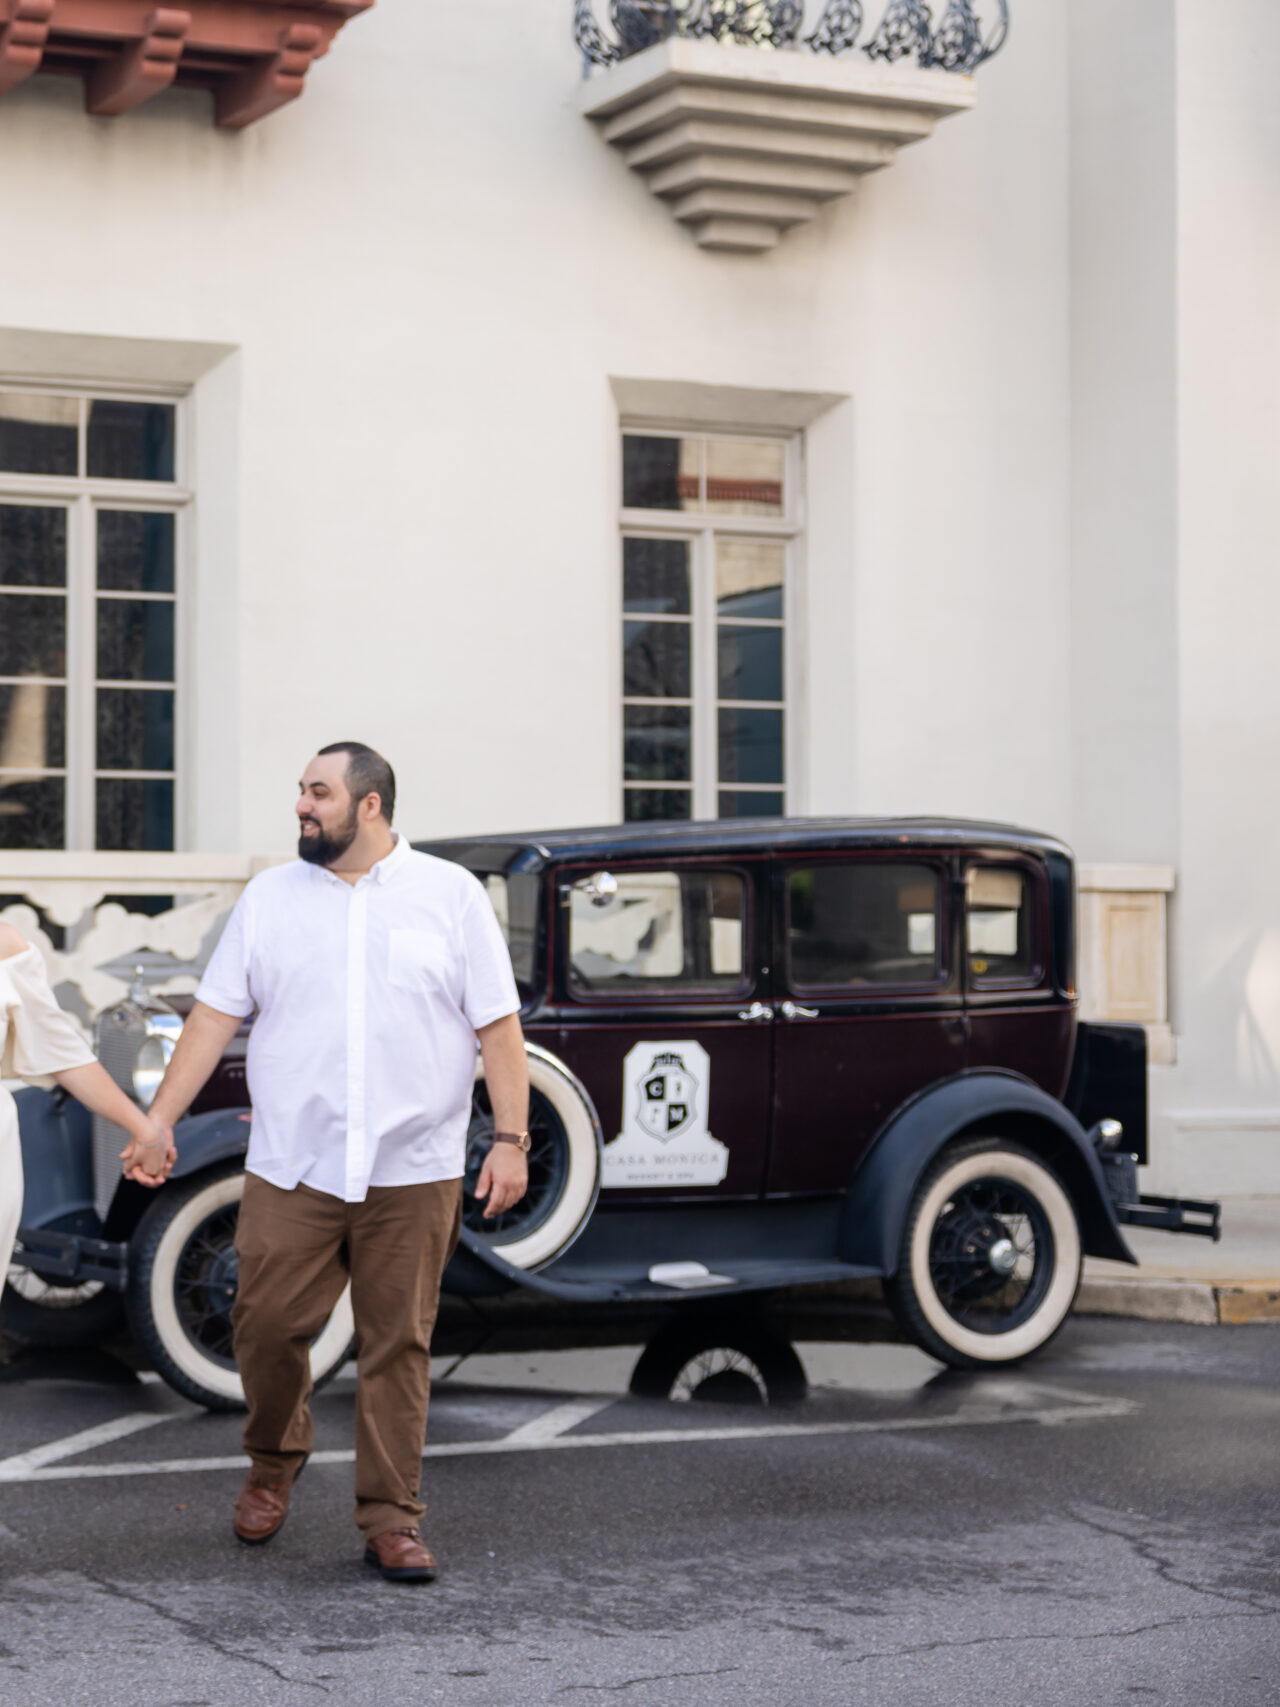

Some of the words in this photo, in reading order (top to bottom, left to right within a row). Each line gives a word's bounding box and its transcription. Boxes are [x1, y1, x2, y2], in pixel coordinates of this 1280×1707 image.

[649, 1081, 663, 1097] C
[670, 1107, 684, 1121] M
[606, 1154, 646, 1166] CASA
[654, 1152, 718, 1165] MONICA
